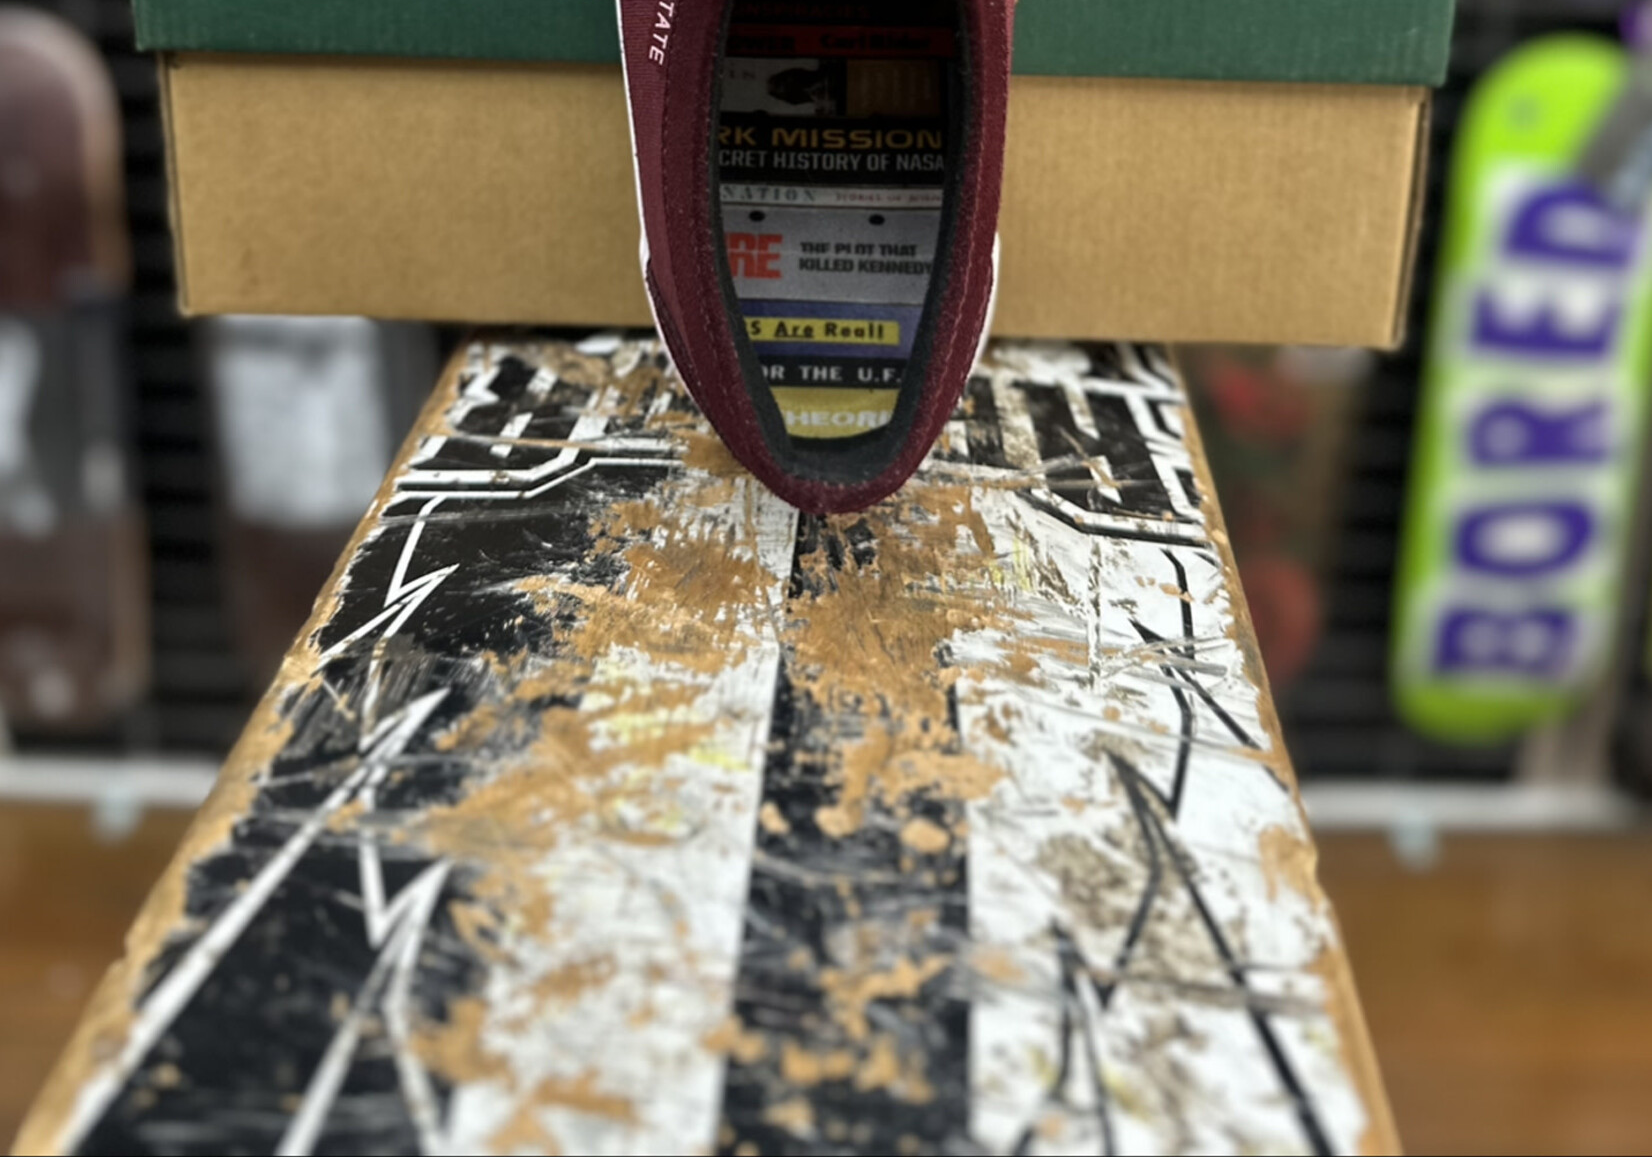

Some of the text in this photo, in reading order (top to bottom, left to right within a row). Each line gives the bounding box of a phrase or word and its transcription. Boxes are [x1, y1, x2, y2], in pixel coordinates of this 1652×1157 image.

[771, 127, 942, 150] MISSION
[773, 151, 861, 171] HISTORY
[866, 153, 891, 172] OF
[896, 153, 945, 172] NASA
[800, 242, 917, 257] THE PLOT THAT
[799, 257, 932, 275] KILLED KENNEDY
[774, 320, 815, 339] Are
[799, 365, 843, 382] THE
[1430, 179, 1640, 682] BORED
